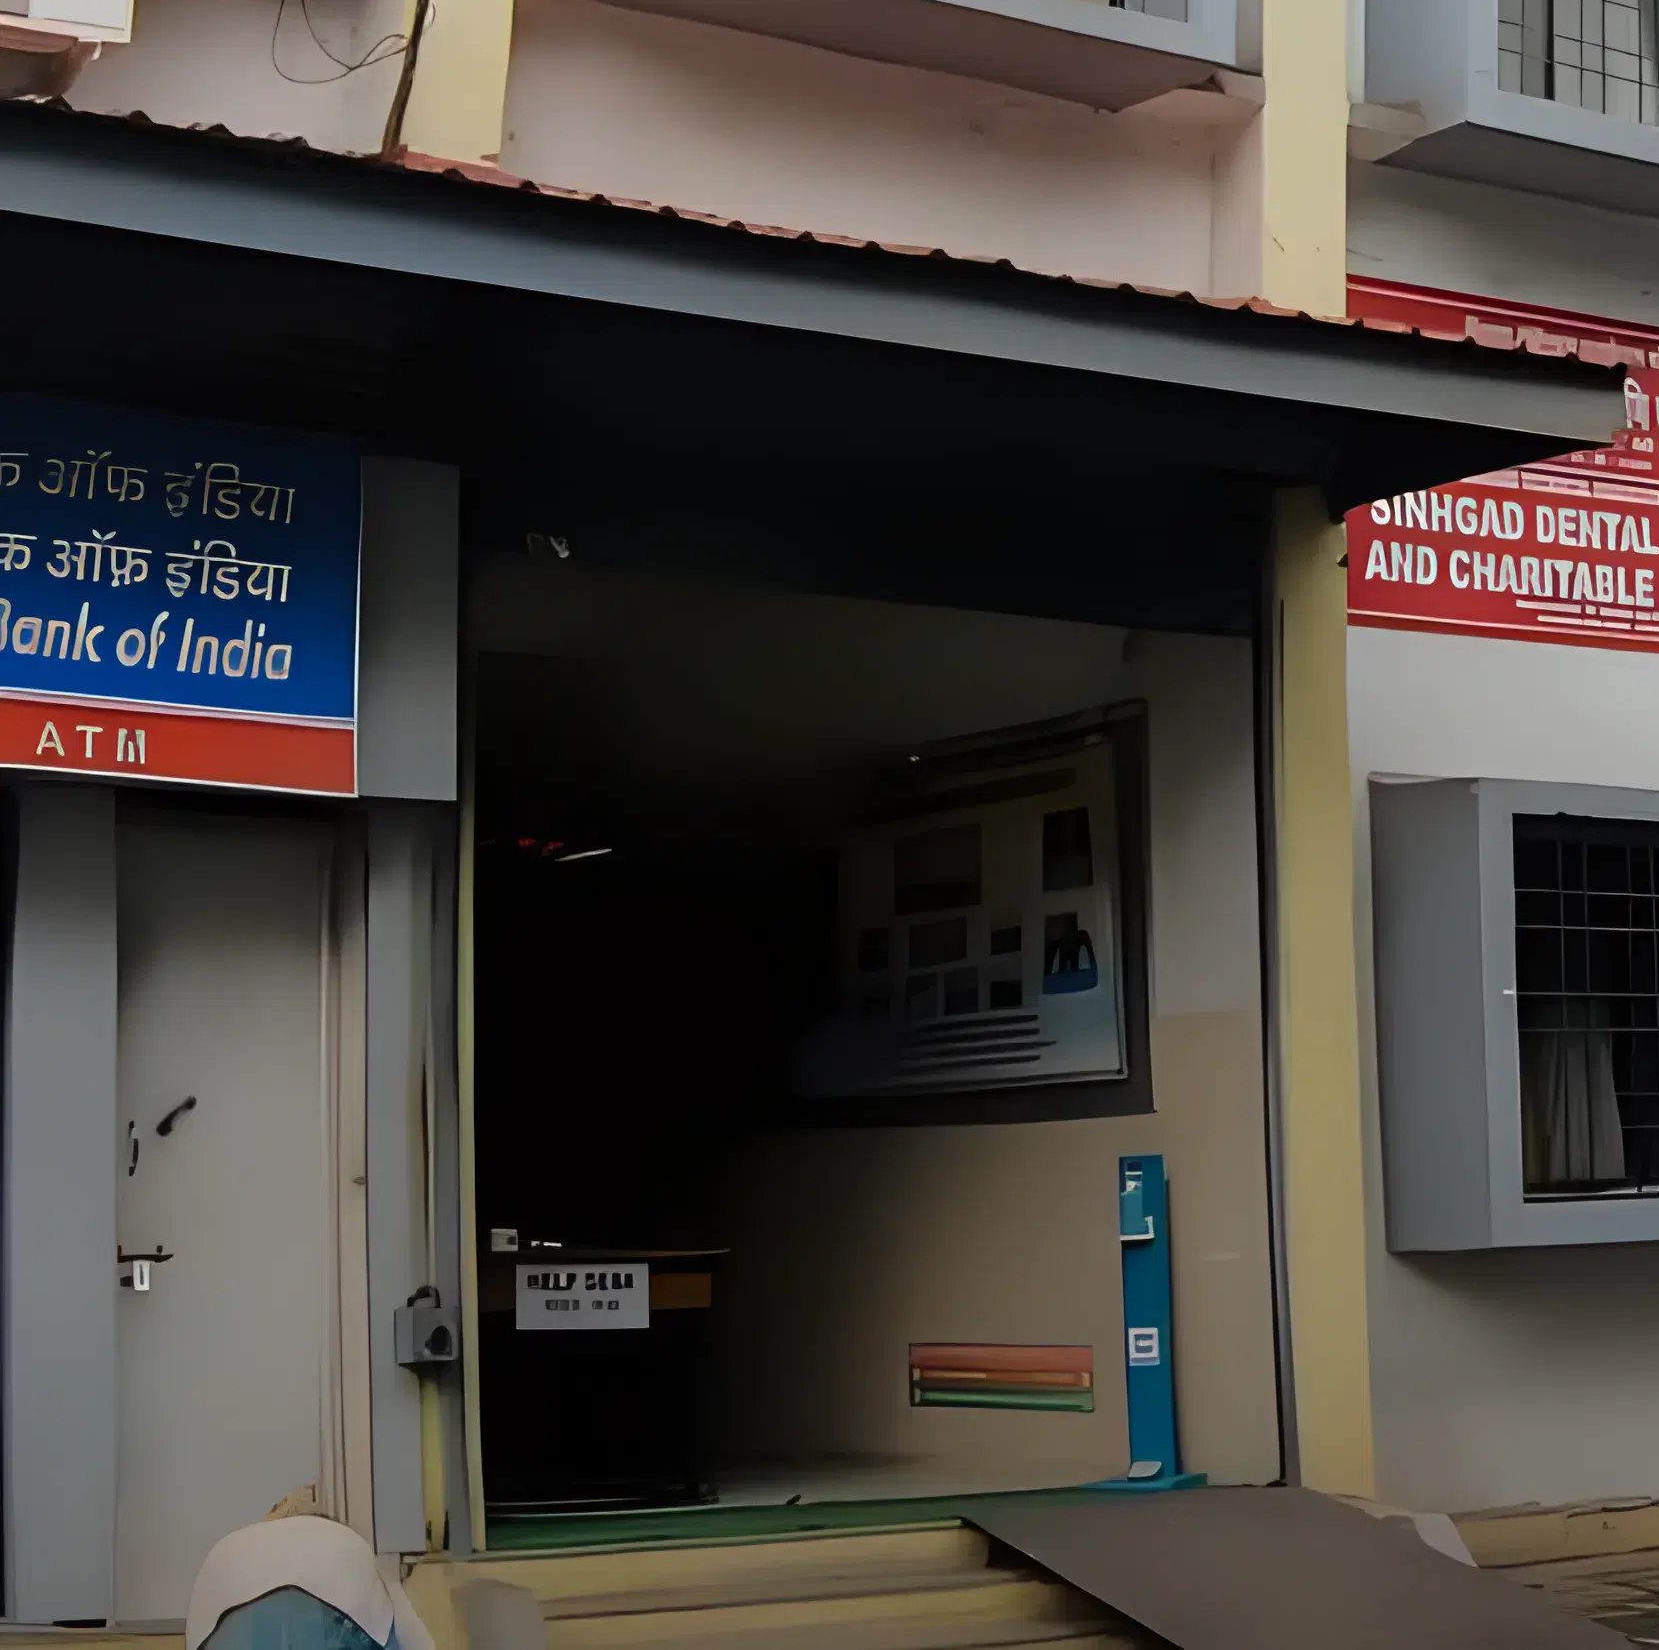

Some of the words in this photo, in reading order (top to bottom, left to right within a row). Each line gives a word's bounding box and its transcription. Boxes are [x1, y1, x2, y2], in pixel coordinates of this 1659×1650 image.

[163, 462, 296, 524] इंडिया
[1370, 490, 1524, 541] SINHGAD
[1535, 504, 1659, 555] DENTAL
[165, 540, 292, 603] इंडिया
[1364, 539, 1438, 586] AND
[1449, 549, 1655, 608] CHARITABLE
[115, 610, 170, 670] of
[176, 617, 293, 680] India
